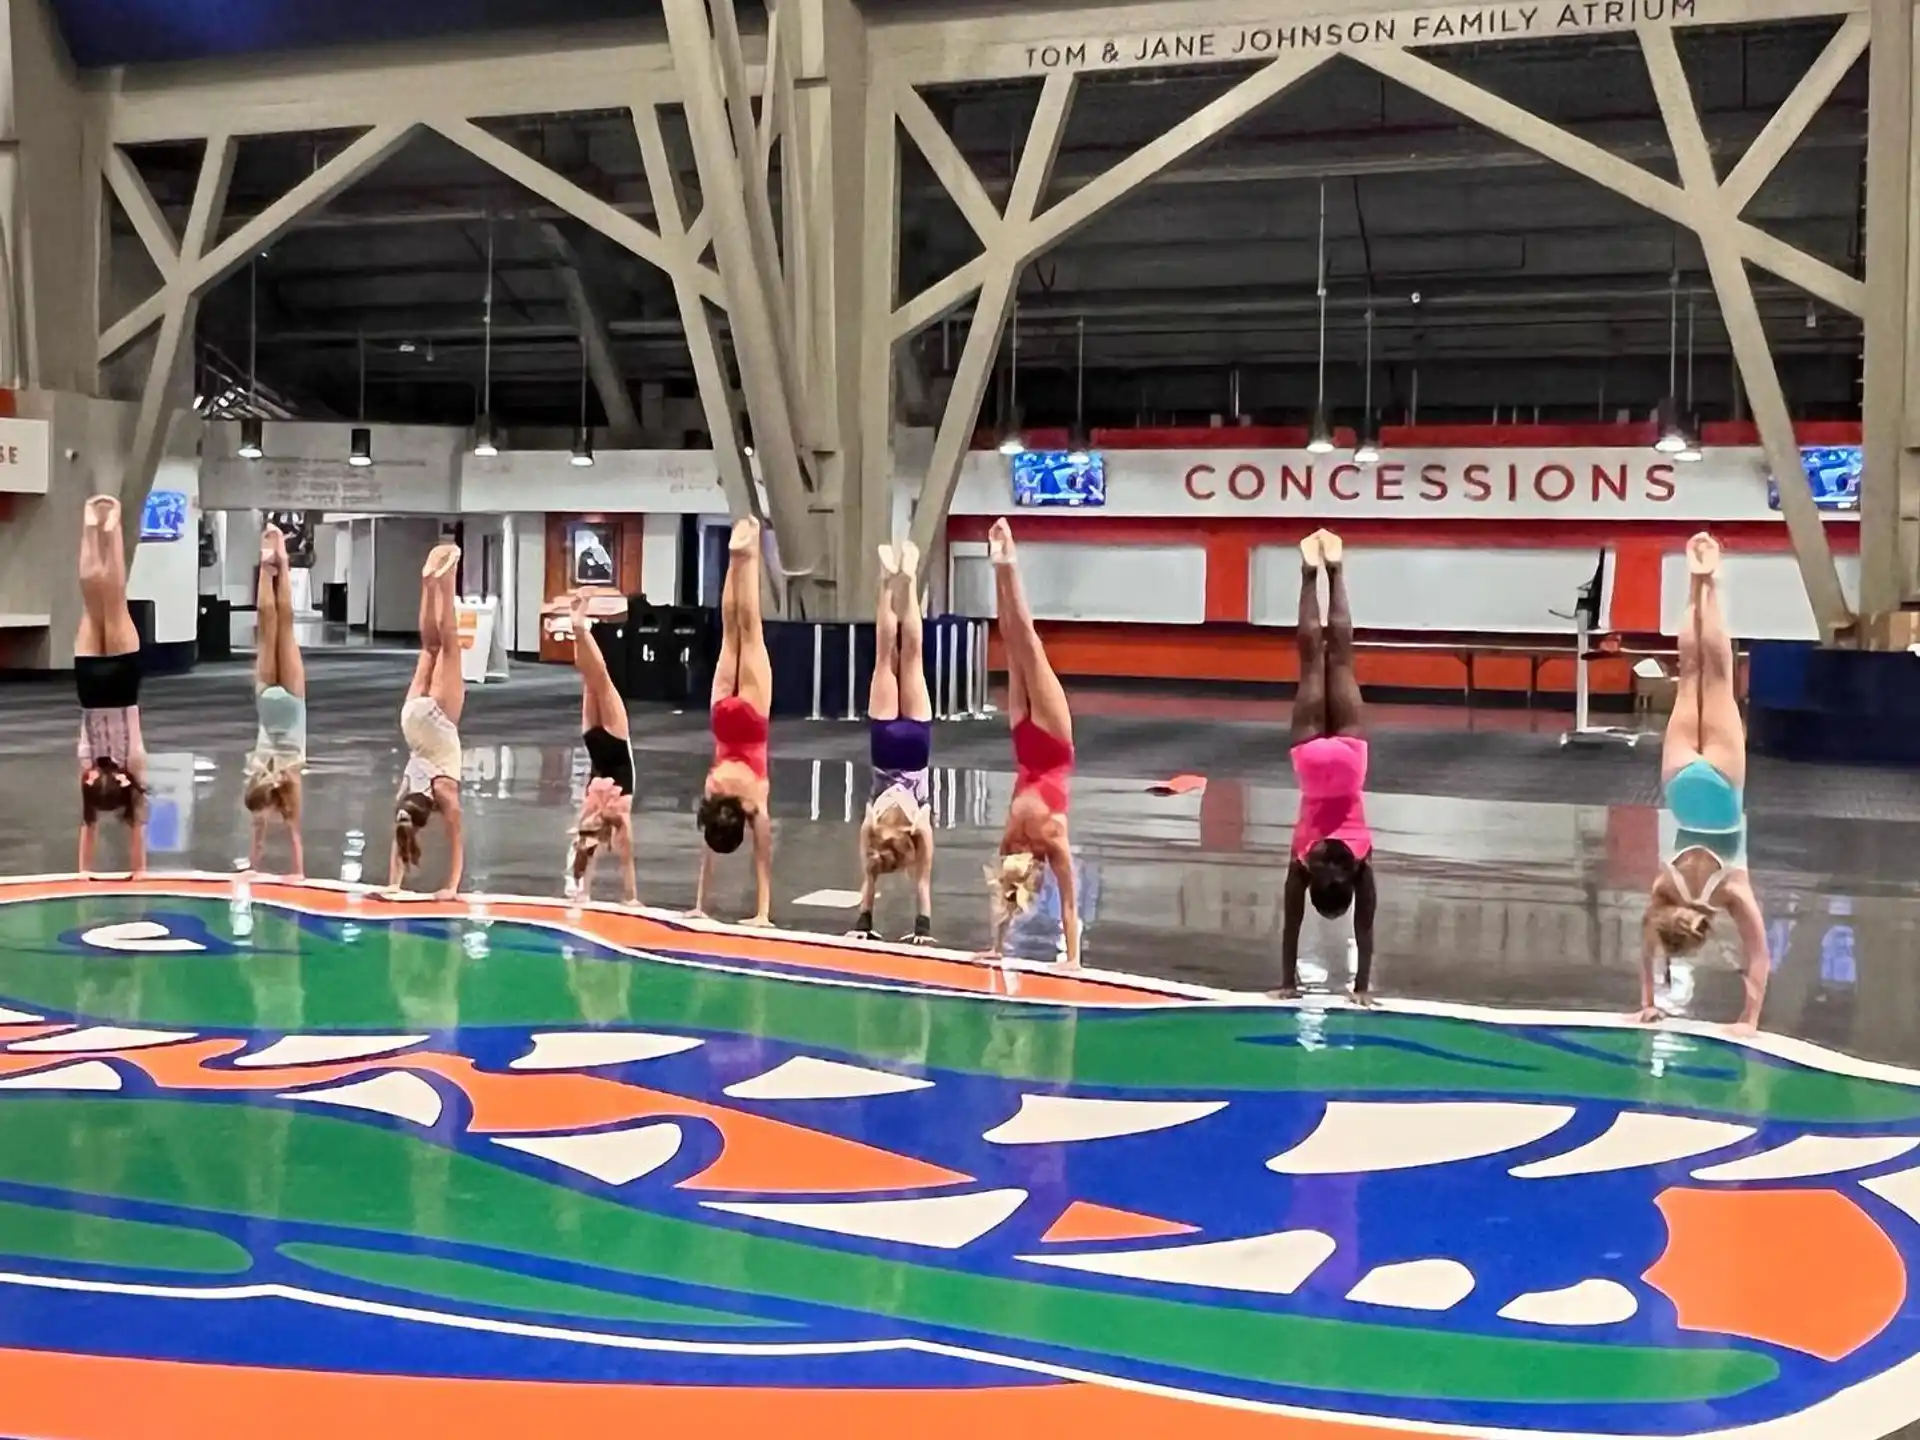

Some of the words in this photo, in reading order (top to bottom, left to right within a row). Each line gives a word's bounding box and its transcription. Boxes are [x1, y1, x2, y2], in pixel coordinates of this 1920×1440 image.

[1025, 43, 1086, 68] TOM
[1102, 41, 1120, 63] &
[1135, 34, 1215, 60] JANE
[1232, 20, 1395, 53] JOHNSON
[1413, 7, 1538, 38] FAMILY
[1557, 0, 1695, 27] ATRIUM
[1184, 464, 1676, 502] CONCESSIONS
